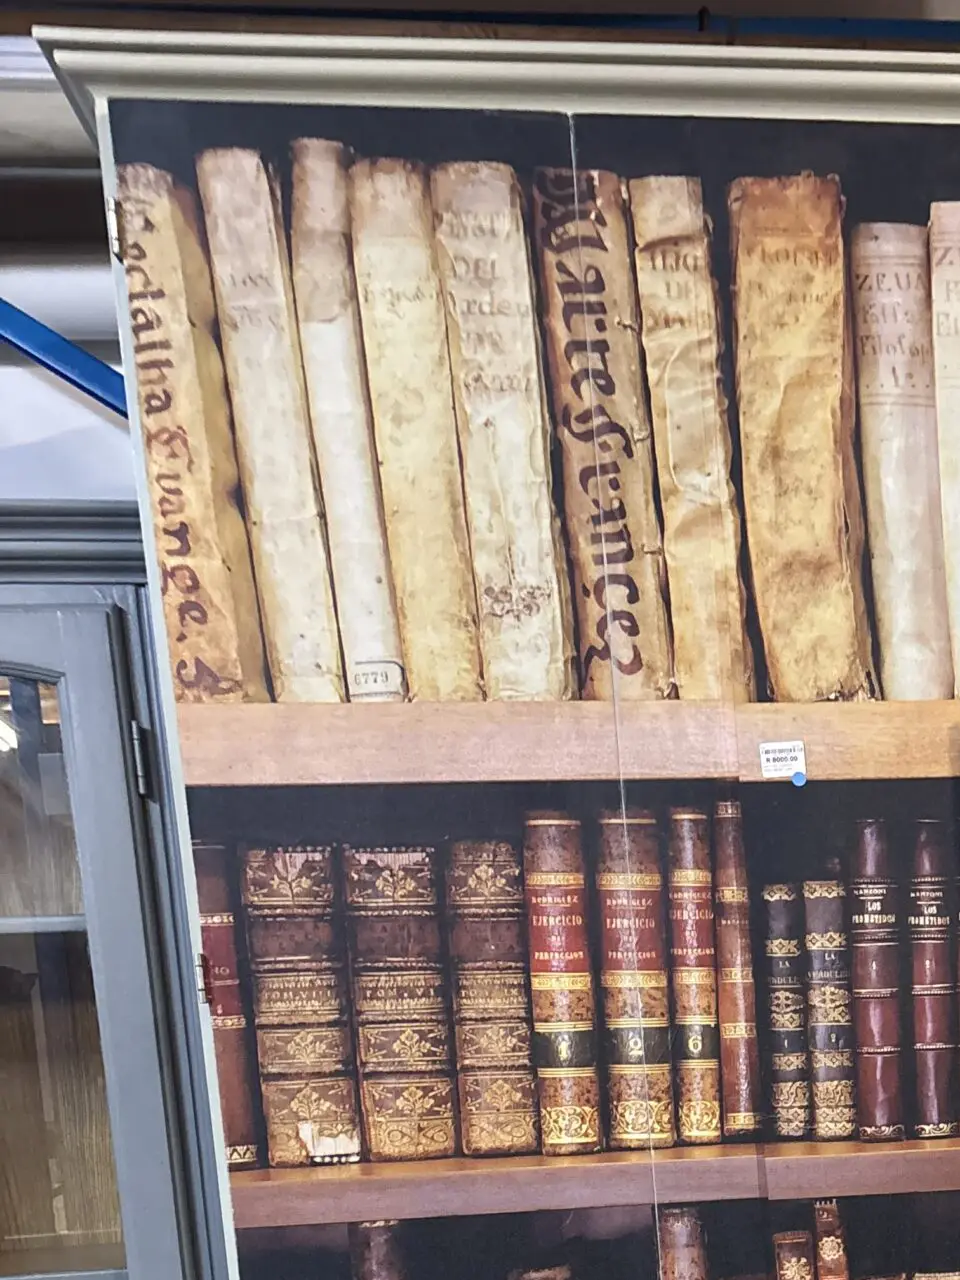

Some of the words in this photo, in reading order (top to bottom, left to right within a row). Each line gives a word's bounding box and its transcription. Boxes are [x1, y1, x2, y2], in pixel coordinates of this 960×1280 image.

[867, 901, 882, 911] LOS
[923, 905, 937, 915] LOS
[688, 1034, 703, 1055] 6
